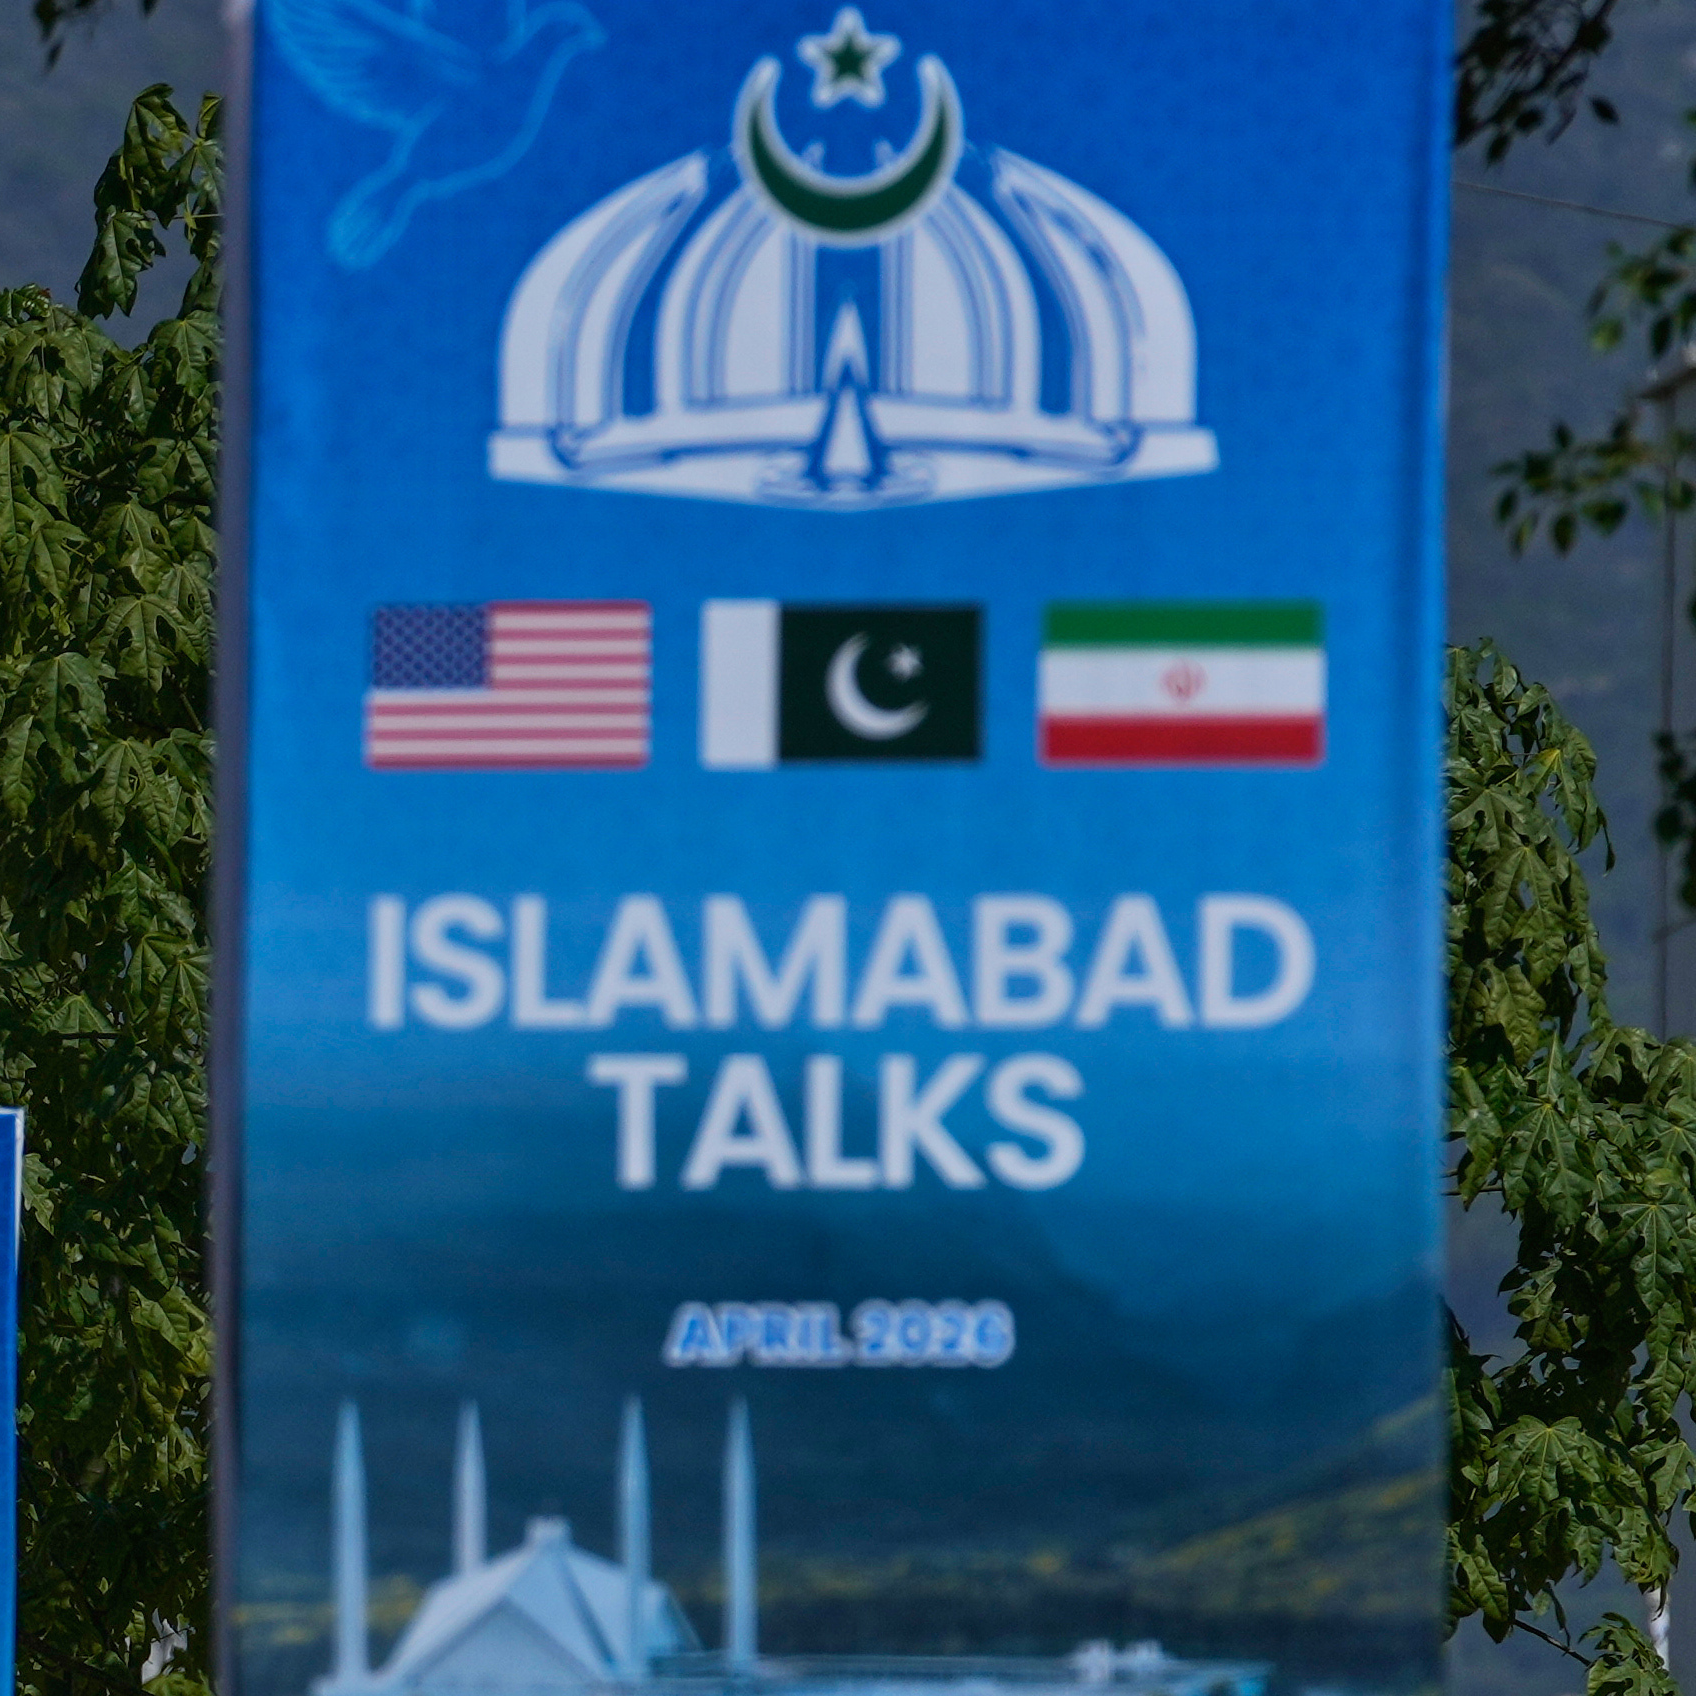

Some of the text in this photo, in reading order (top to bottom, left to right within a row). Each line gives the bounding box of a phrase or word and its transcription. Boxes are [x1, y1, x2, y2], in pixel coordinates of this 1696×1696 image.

[364, 892, 1317, 1031] ISLAMABAD
[586, 1053, 1086, 1191] TALKS
[665, 1298, 1014, 1369] APRIL 2026
